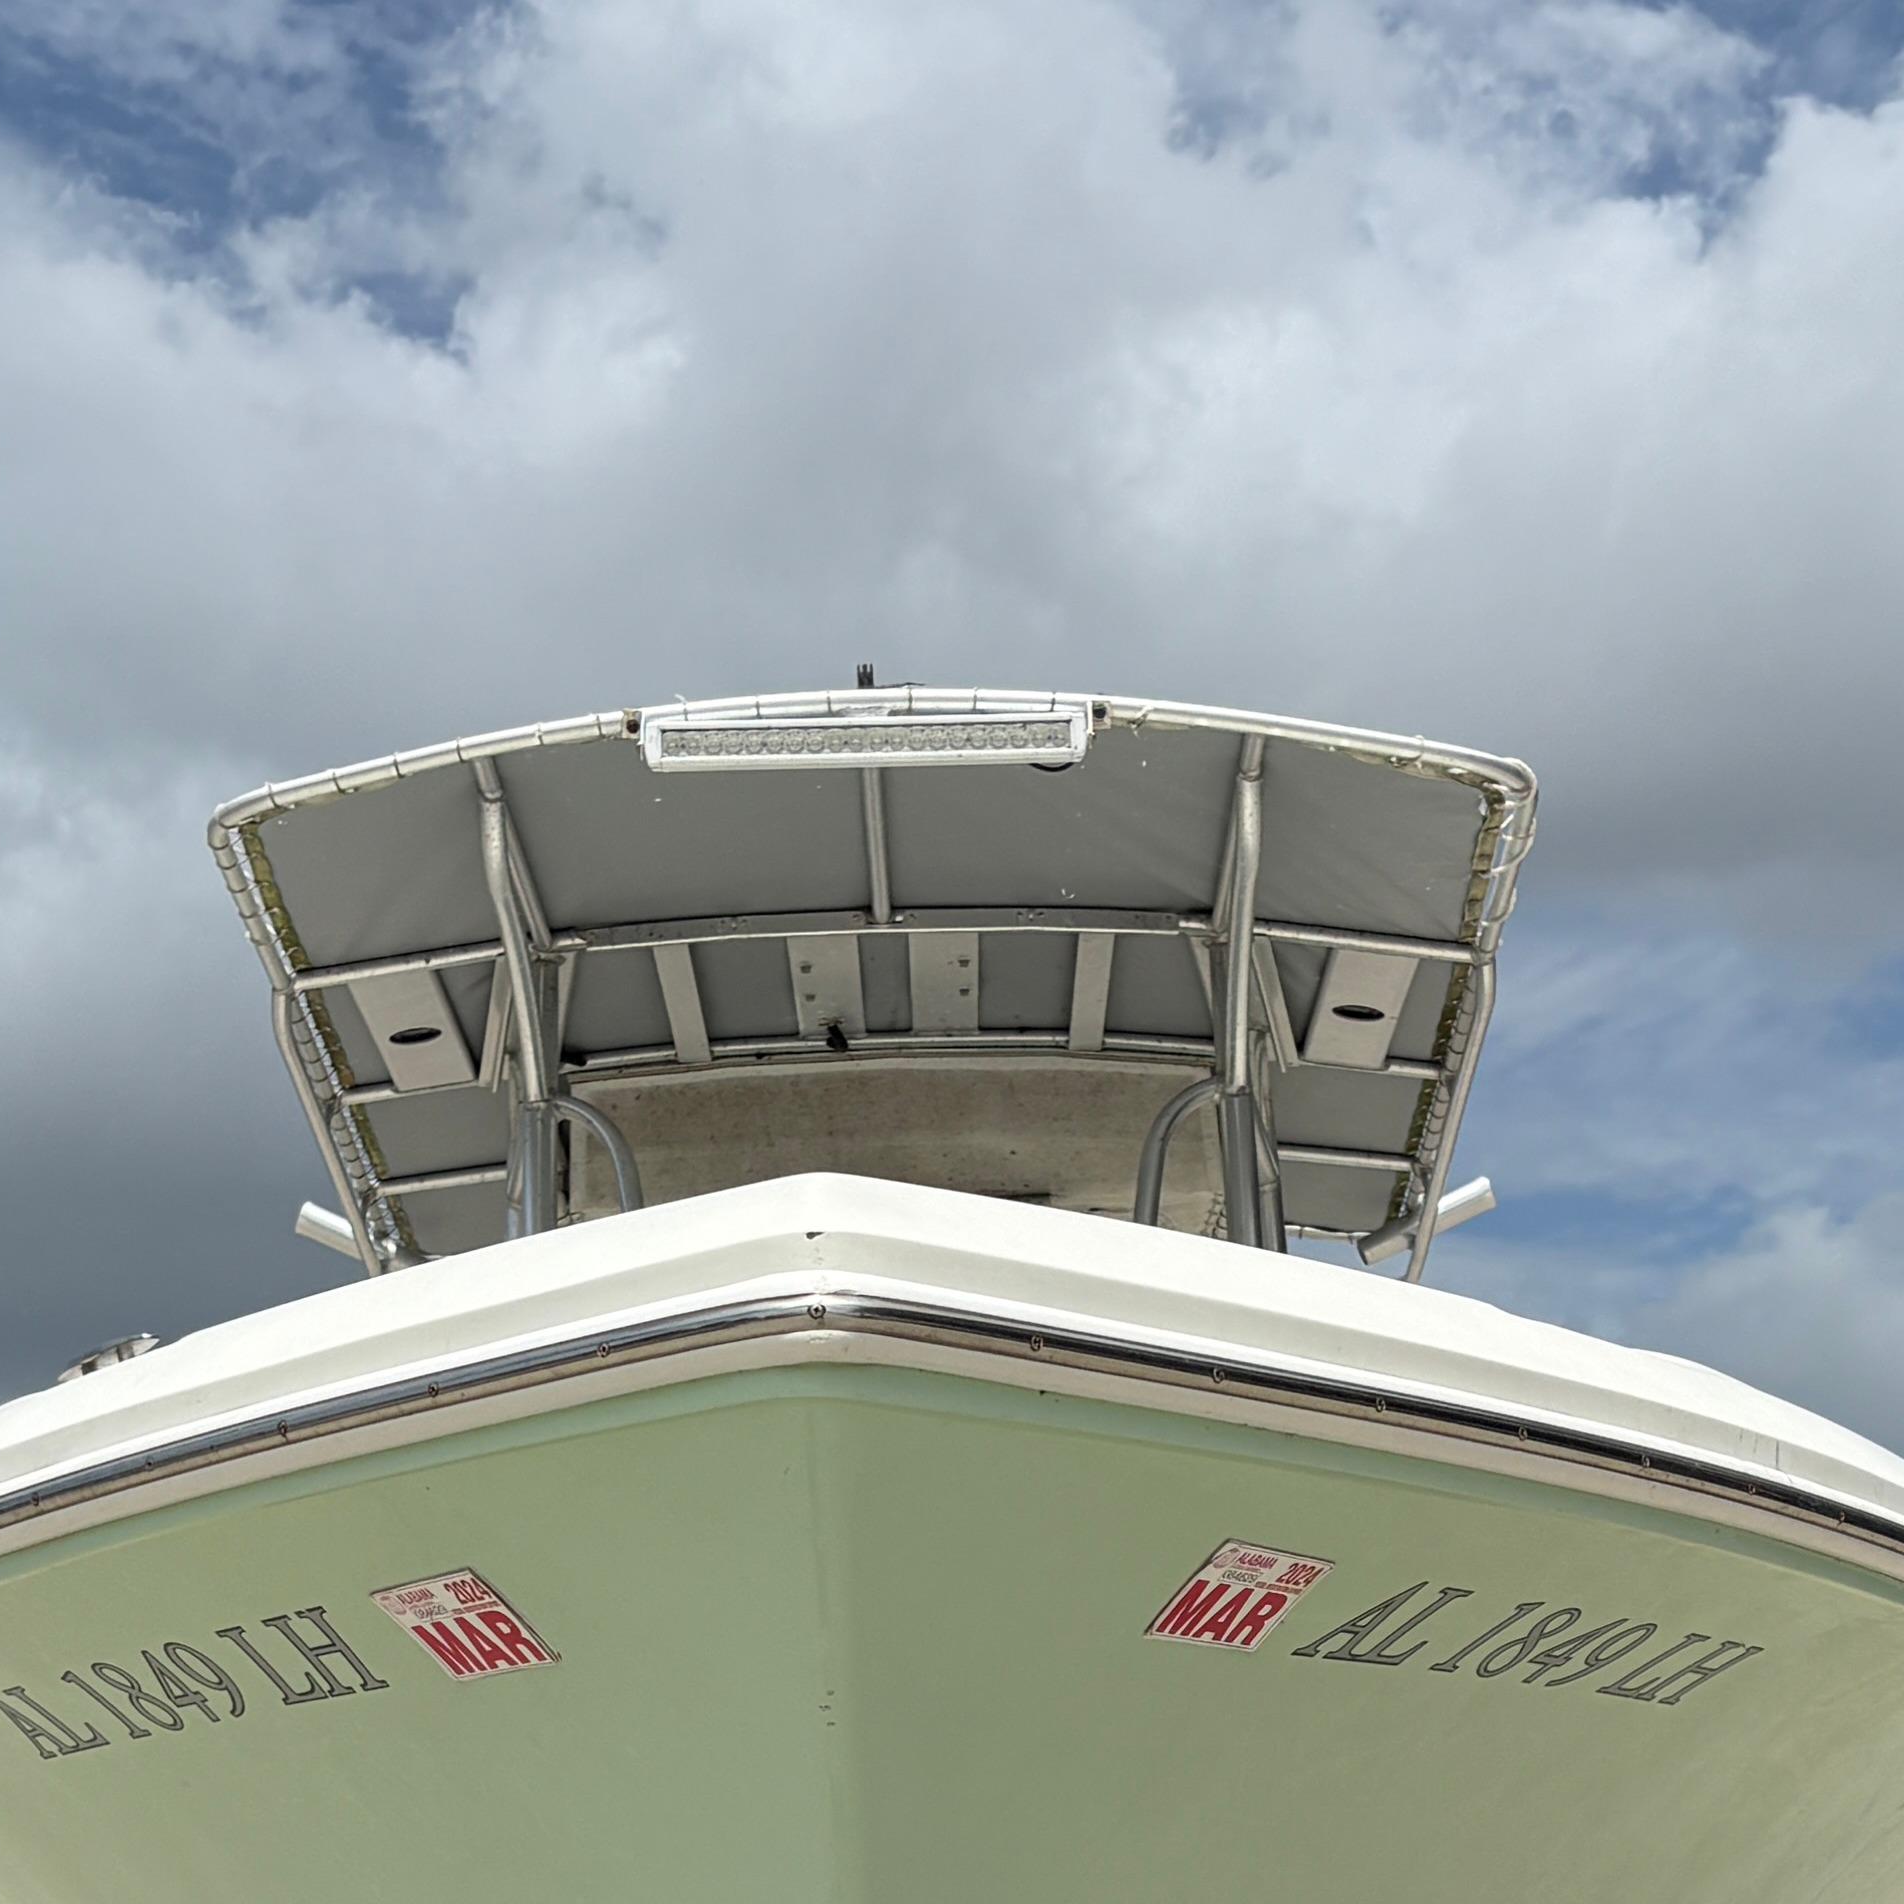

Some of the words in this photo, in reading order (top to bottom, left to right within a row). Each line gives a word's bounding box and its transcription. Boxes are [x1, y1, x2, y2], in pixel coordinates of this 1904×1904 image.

[443, 1577, 493, 1604] 2024
[1275, 1562, 1324, 1587] 2024
[411, 1610, 548, 1675] MAR
[1155, 1579, 1288, 1646] MAR
[1291, 1581, 1474, 1666] AL
[1429, 1601, 1658, 1687] 1849
[1596, 1634, 1764, 1706] LH
[61, 1642, 246, 1739] 1849
[216, 1606, 389, 1706] LH
